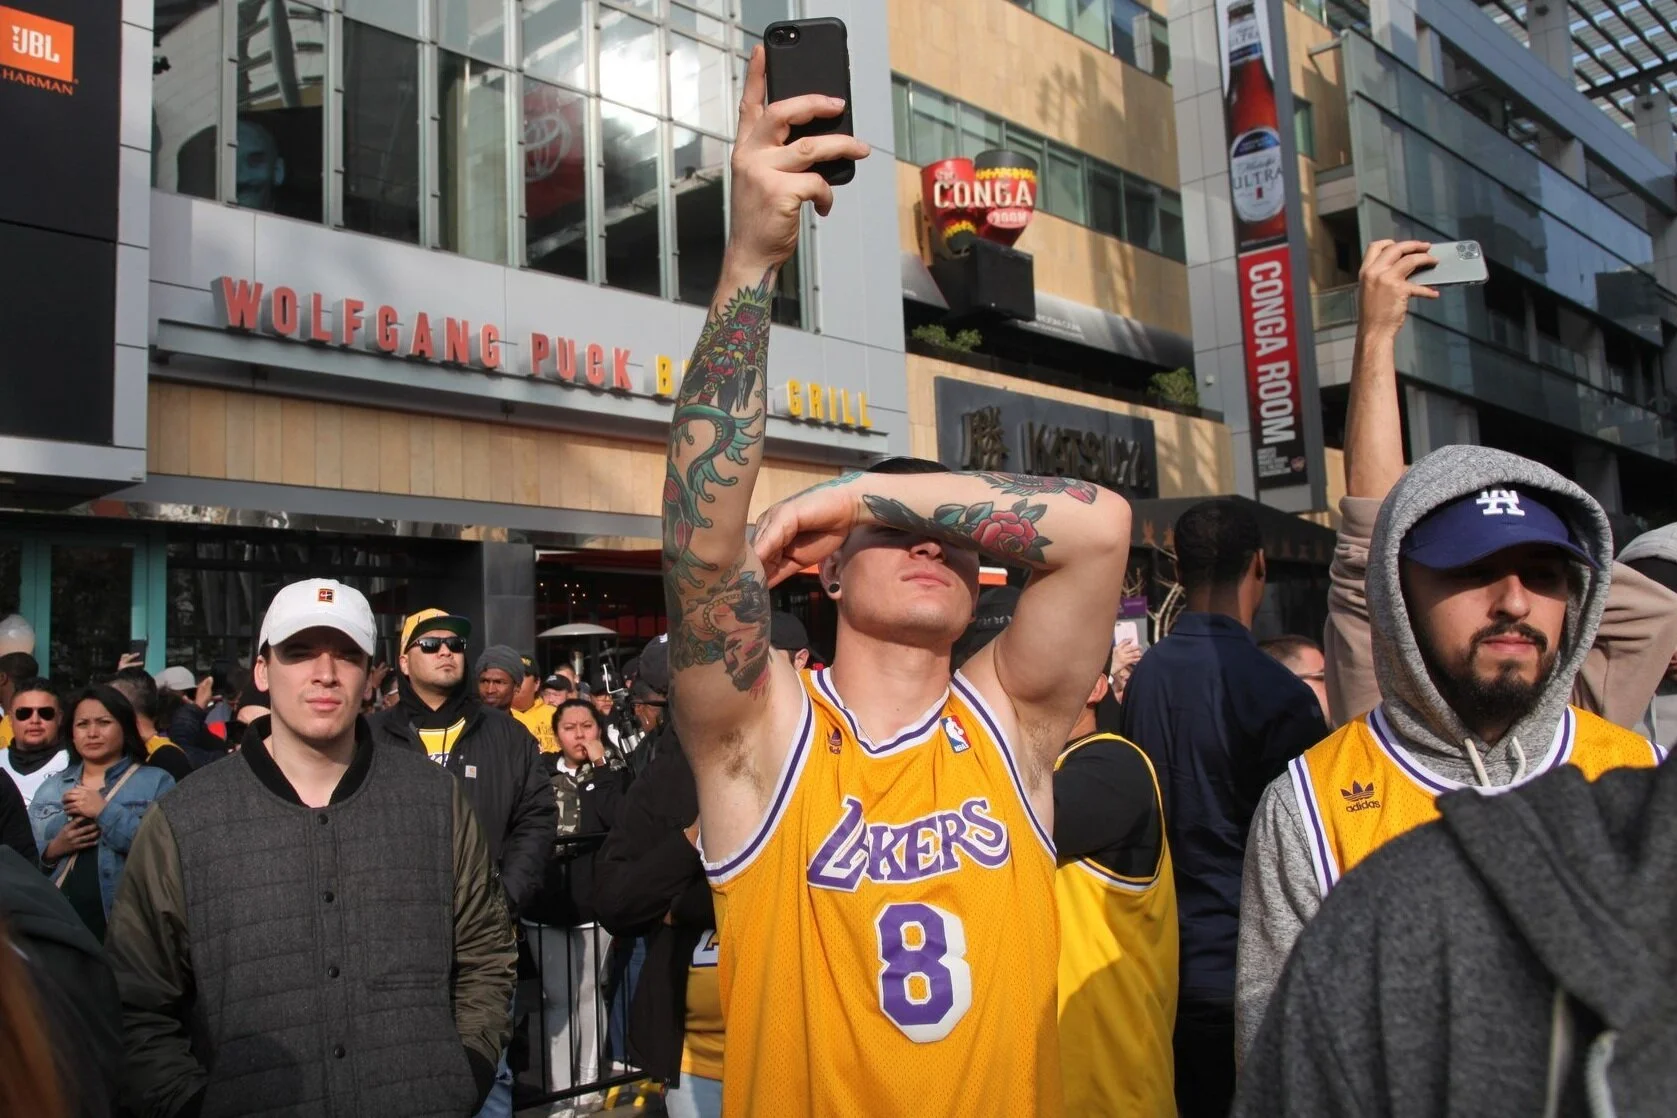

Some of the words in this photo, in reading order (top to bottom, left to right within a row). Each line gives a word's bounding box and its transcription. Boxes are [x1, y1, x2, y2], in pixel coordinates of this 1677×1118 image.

[12, 24, 60, 64] JBL
[2, 68, 74, 96] HARMAN
[933, 179, 1033, 208] CONGA
[1232, 167, 1284, 190] ULTRA
[1248, 260, 1288, 358] CONGA
[220, 275, 501, 369] WOLFGANG
[530, 332, 633, 391] PUCK
[785, 378, 873, 429] GRILL
[1256, 359, 1297, 445] ROOM
[1345, 800, 1381, 813] adidas
[873, 902, 973, 1044] 8
